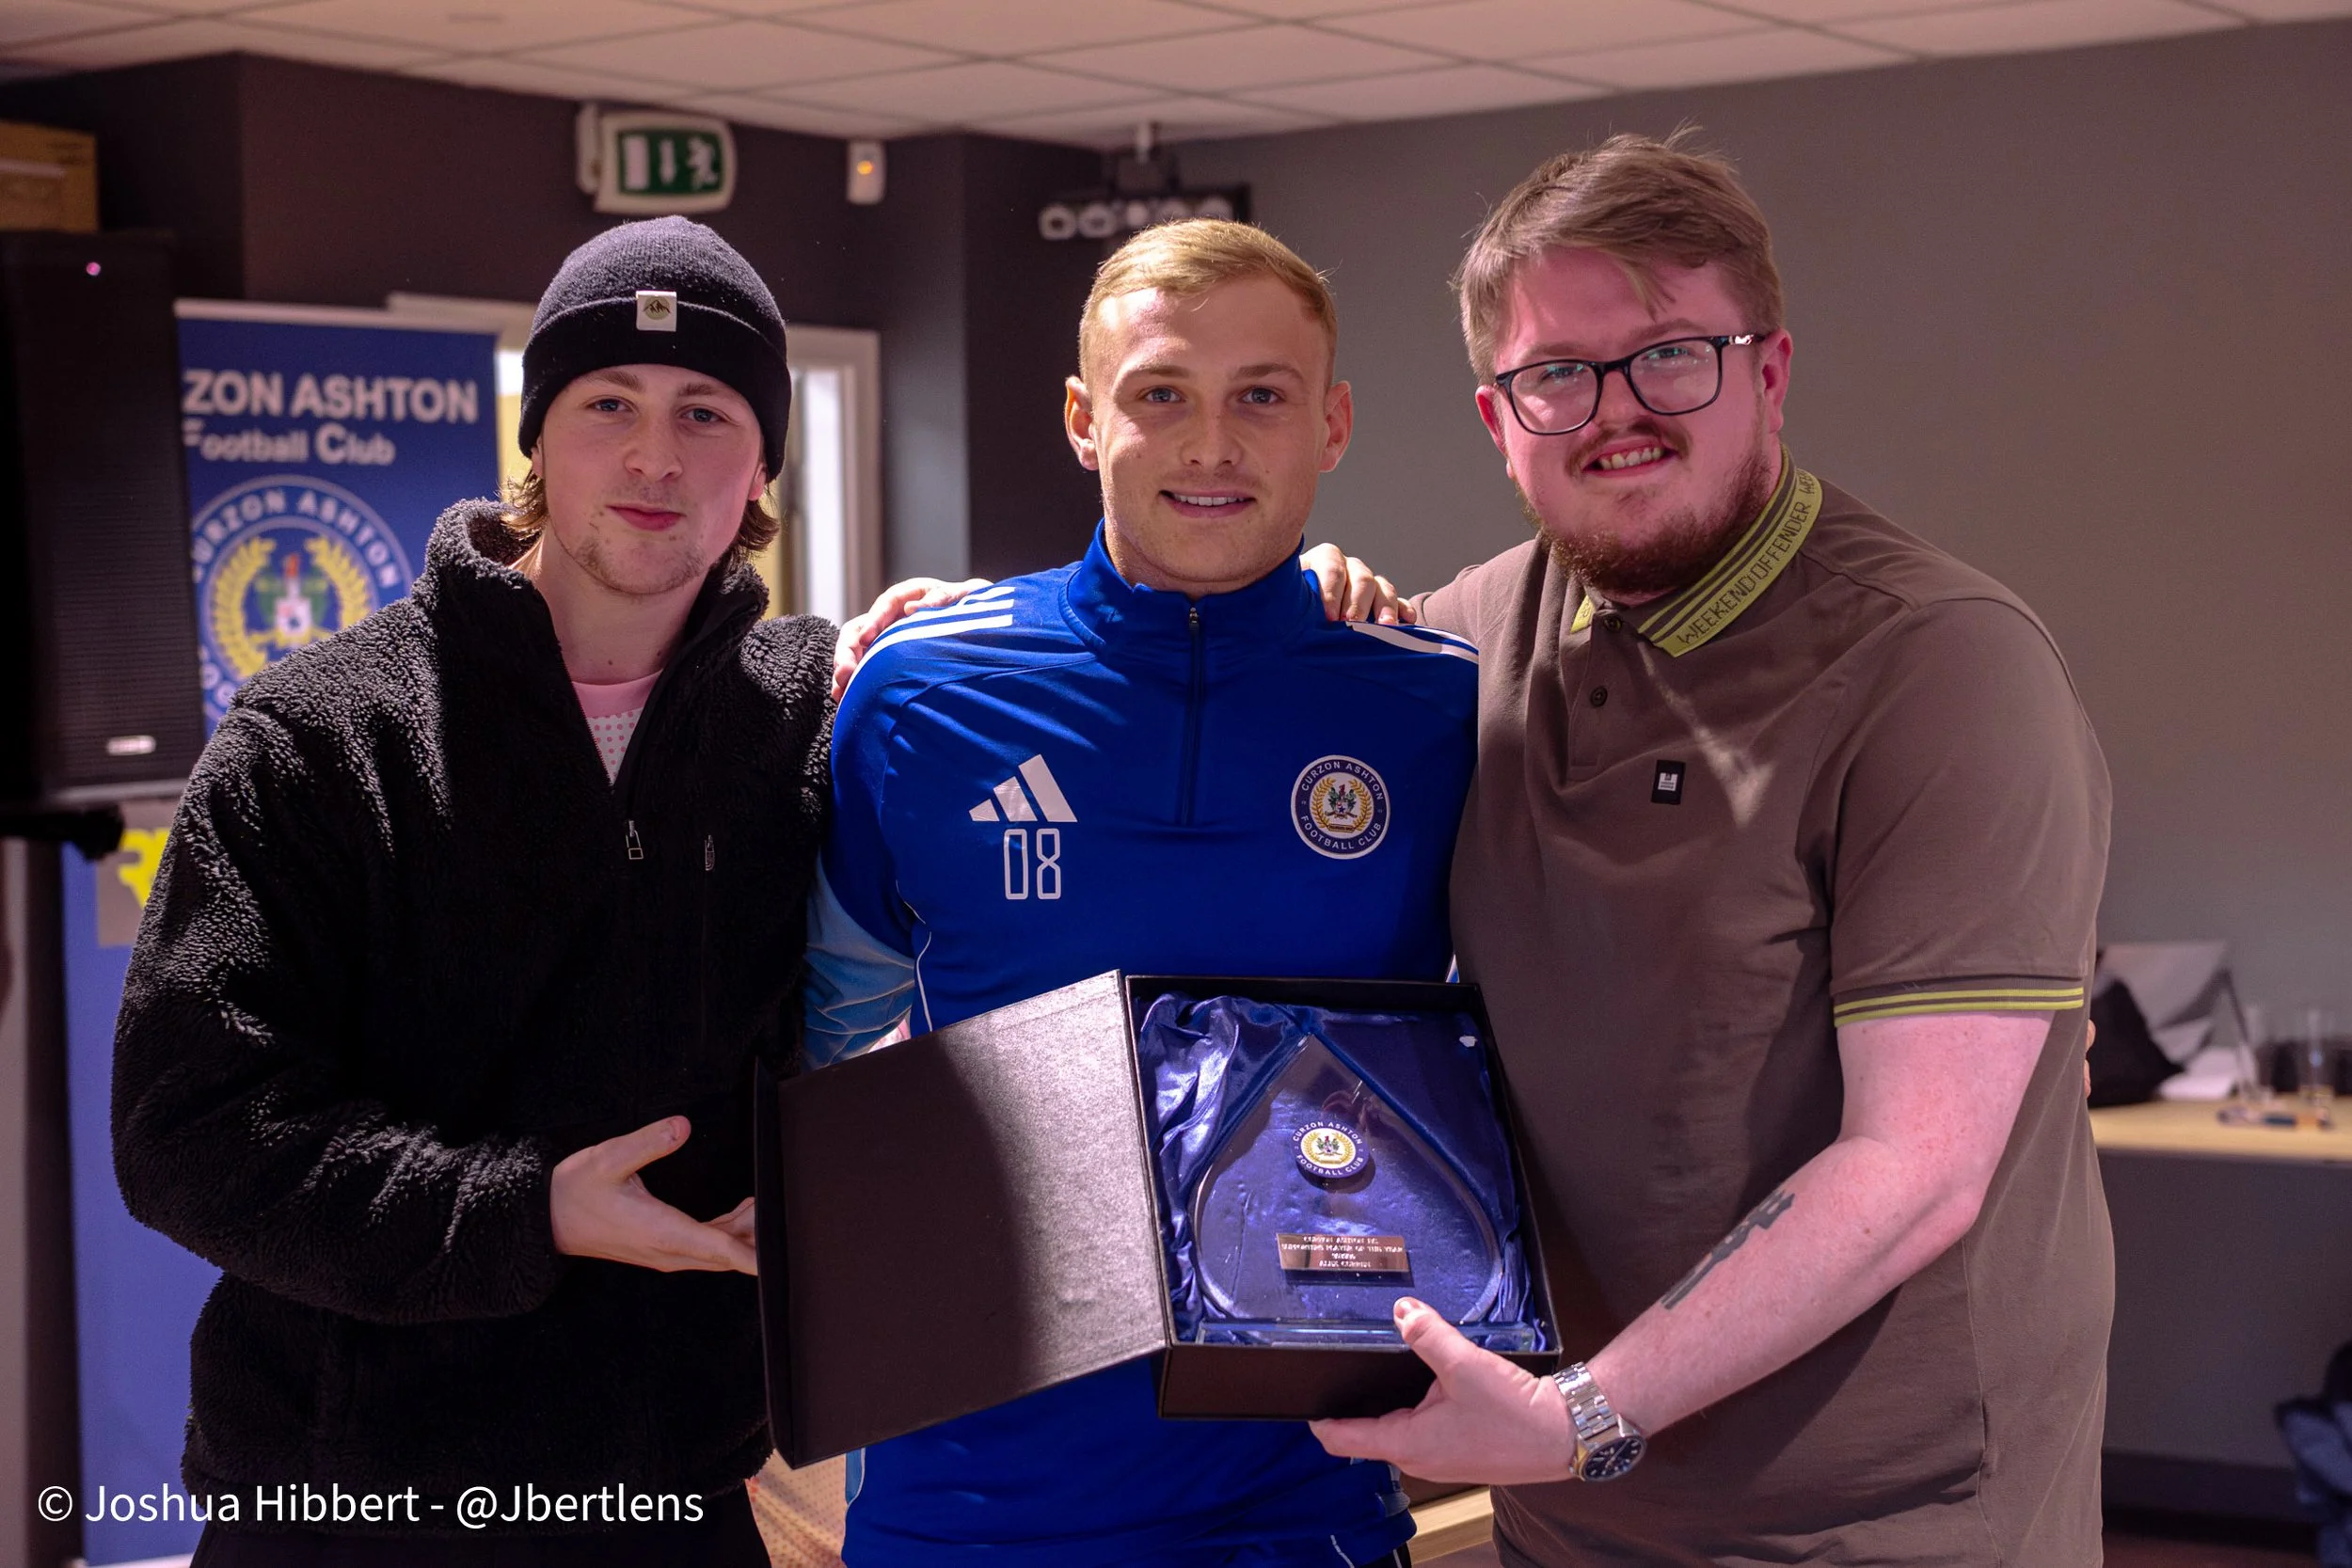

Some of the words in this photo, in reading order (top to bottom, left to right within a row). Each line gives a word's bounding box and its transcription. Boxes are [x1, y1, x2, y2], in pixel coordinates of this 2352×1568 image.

[290, 372, 478, 422] ASHTON
[315, 422, 398, 467] Club
[297, 489, 400, 589] ASHTON
[1301, 761, 1341, 792] CURZON
[1345, 763, 1384, 800] ASHTON
[1300, 815, 1355, 850] FOOTBALL
[1358, 822, 1382, 847] CLUB
[1003, 828, 1061, 900] 08
[1293, 1121, 1324, 1142] CURZON
[1327, 1121, 1363, 1145] ASHTON
[1296, 1154, 1343, 1176] FOOTBALL
[1344, 1157, 1364, 1173] CLUB
